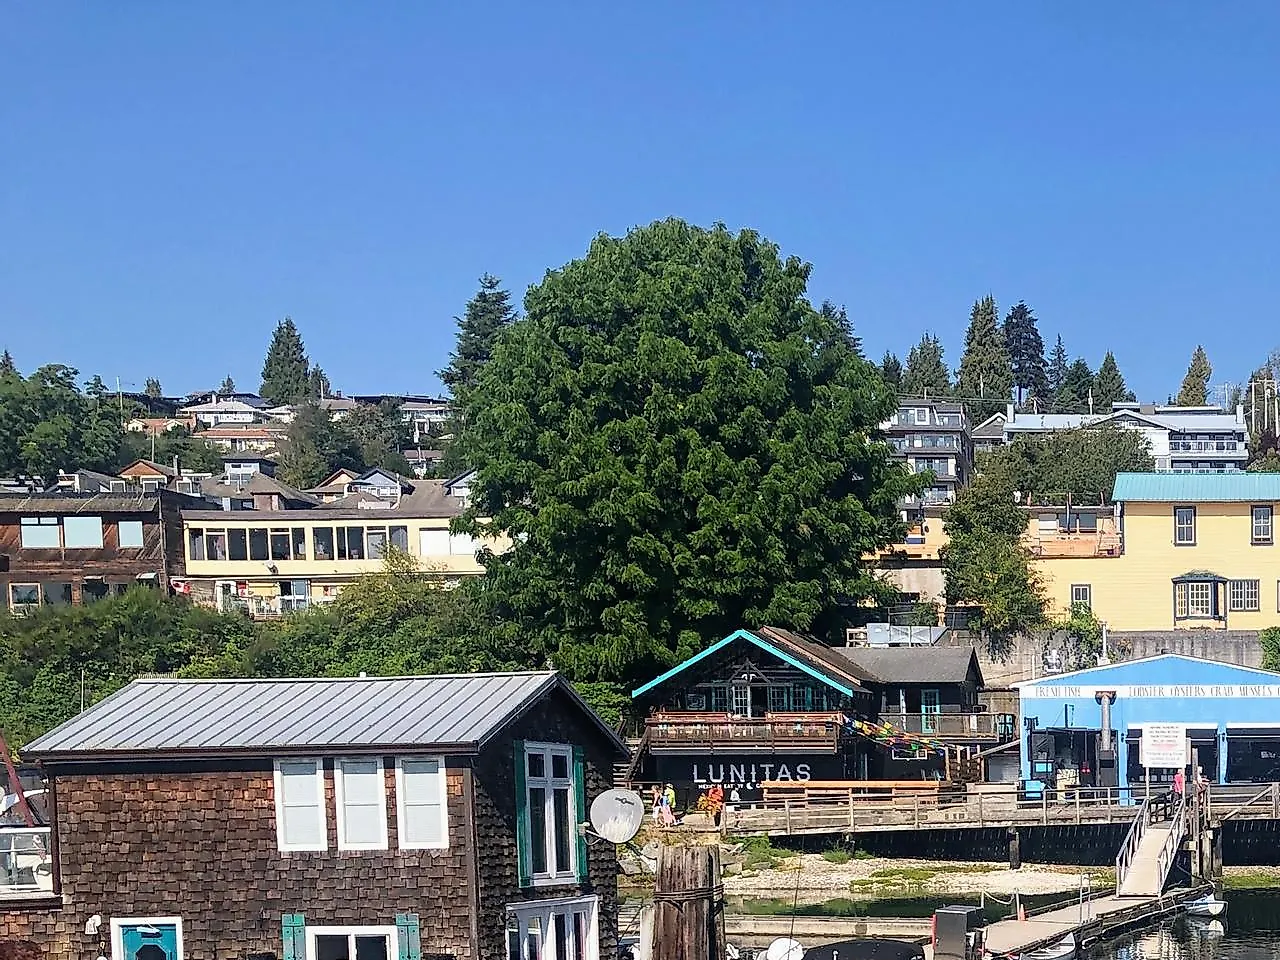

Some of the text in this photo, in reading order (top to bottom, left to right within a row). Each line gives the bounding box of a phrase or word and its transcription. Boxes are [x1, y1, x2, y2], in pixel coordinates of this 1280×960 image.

[1035, 686, 1061, 697] FRESH
[1064, 686, 1081, 697] FISH
[1129, 686, 1164, 697] LOBSTER
[1170, 686, 1206, 697] OYSTERS
[1210, 686, 1234, 697] CRAB
[1239, 686, 1273, 697] MUSSELS
[693, 764, 812, 783] LUNITAS
